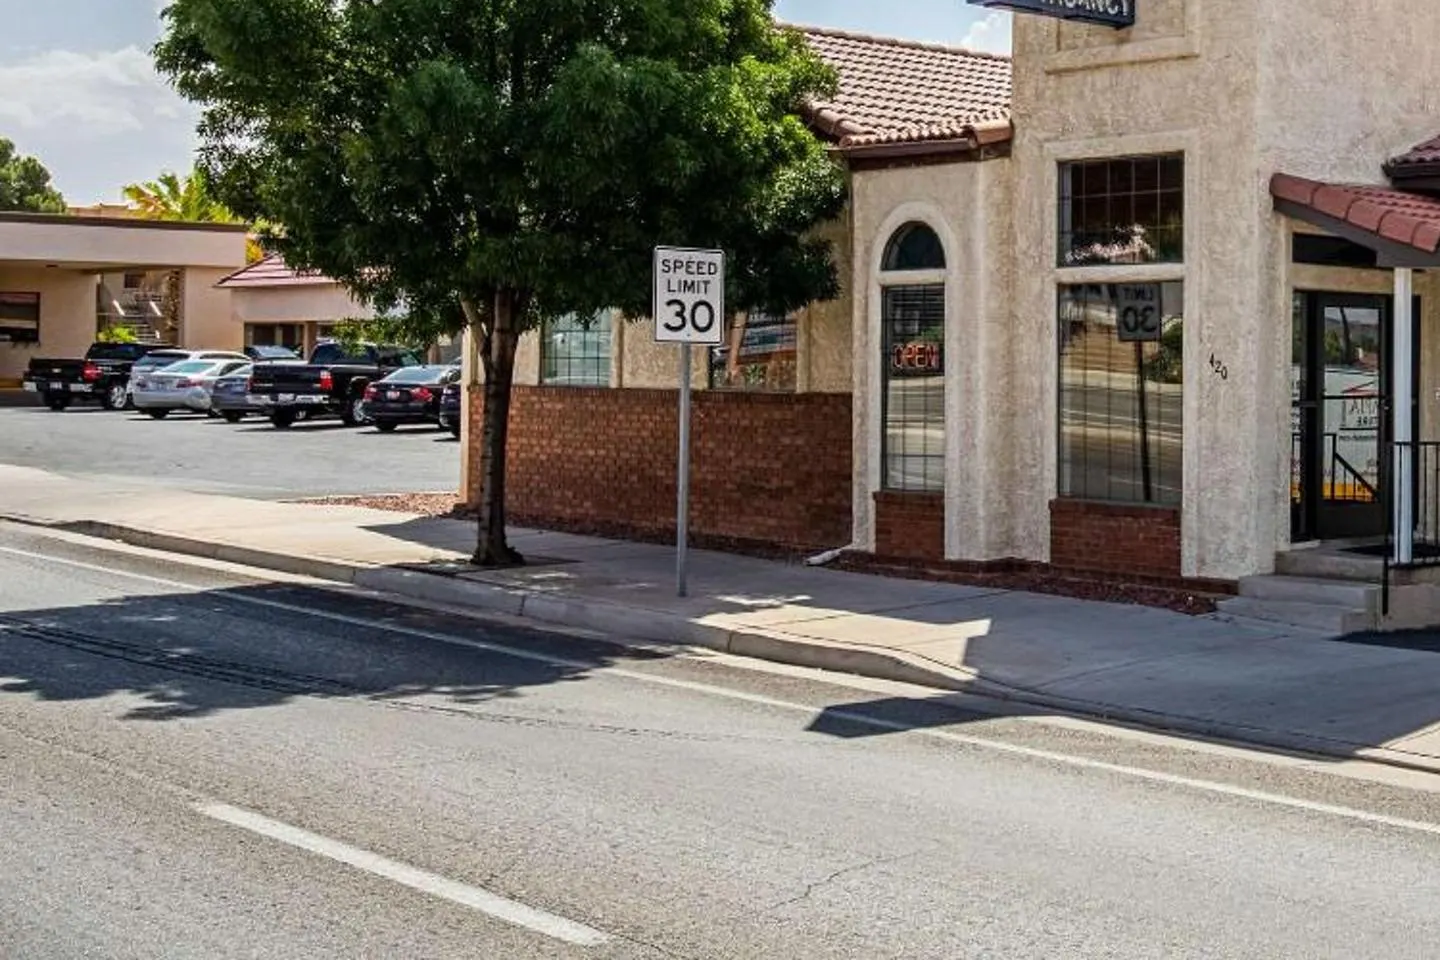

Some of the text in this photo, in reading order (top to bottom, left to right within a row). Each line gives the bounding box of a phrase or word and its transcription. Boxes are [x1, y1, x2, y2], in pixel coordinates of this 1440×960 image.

[661, 258, 718, 275] SPEED
[667, 279, 711, 294] LIMIT
[663, 298, 715, 333] 30
[1209, 352, 1228, 380] 420
